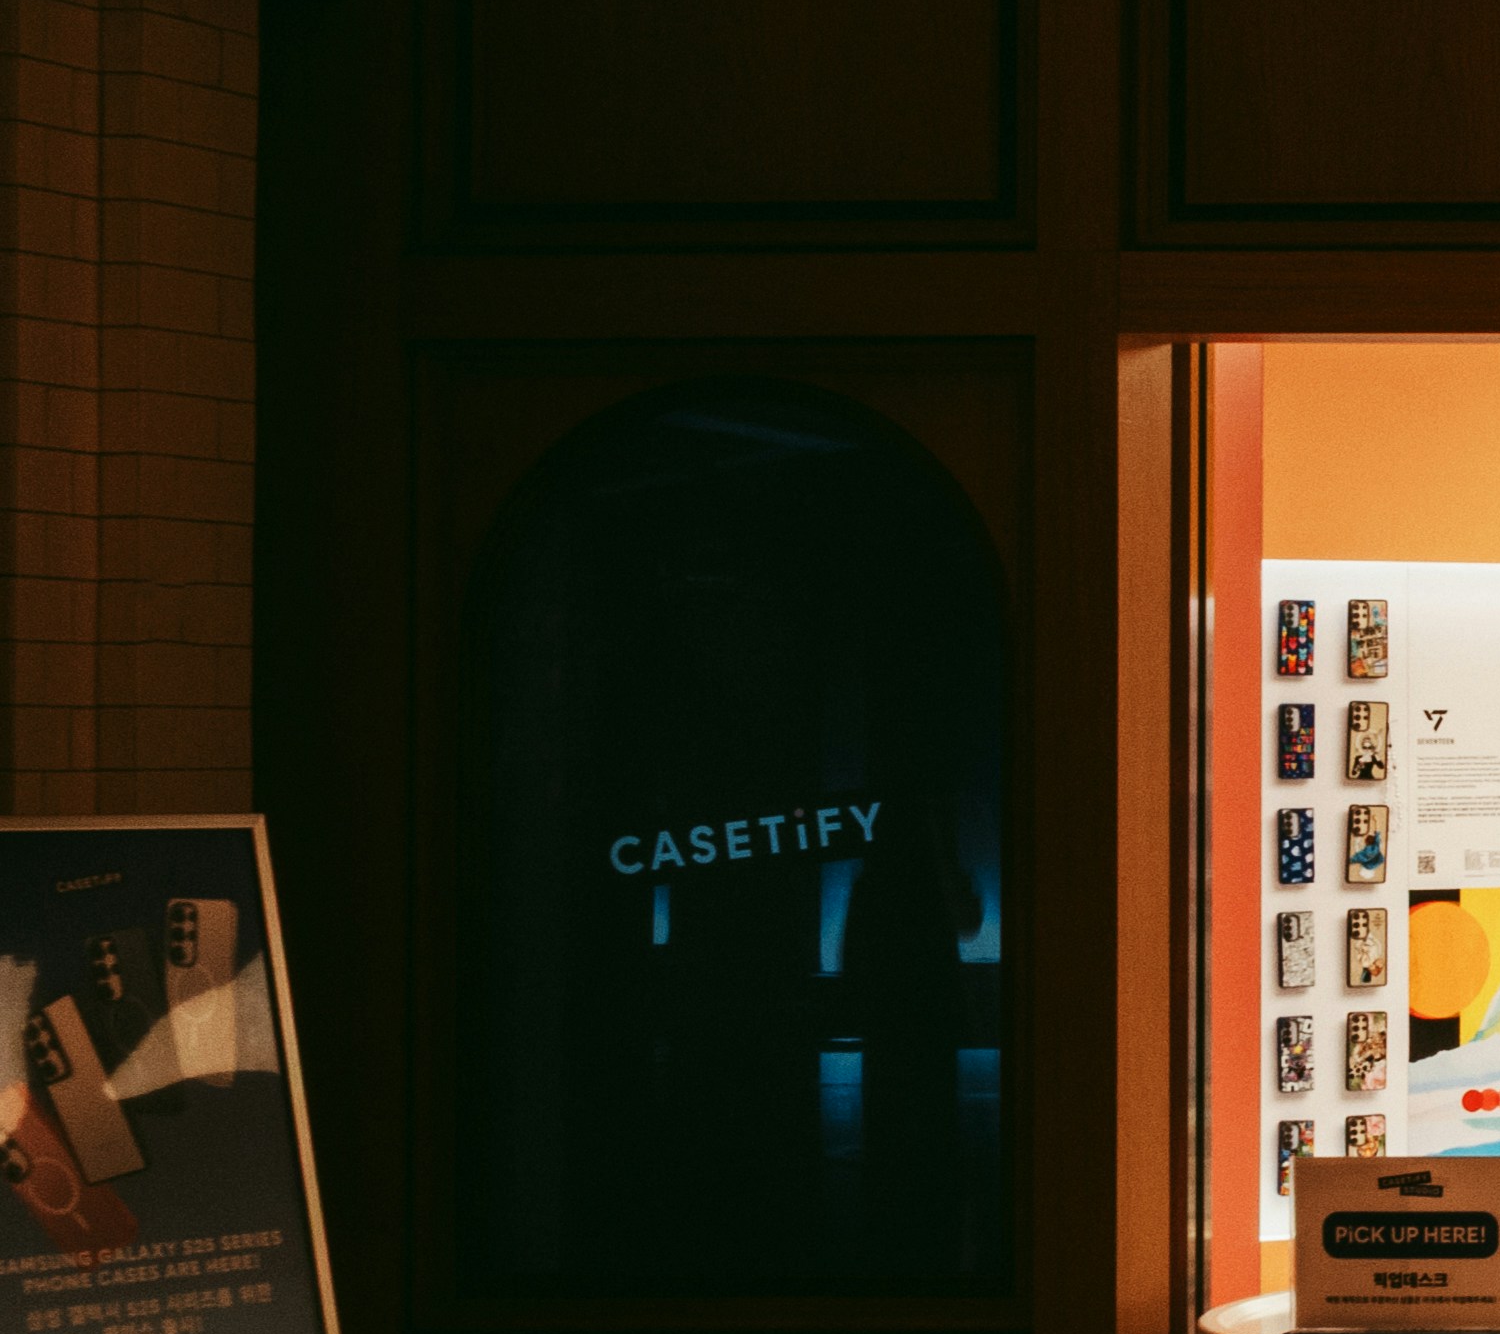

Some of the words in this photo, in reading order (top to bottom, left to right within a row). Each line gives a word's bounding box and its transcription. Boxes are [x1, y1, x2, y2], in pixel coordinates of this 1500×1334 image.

[610, 802, 881, 875] CASETiFY
[97, 1241, 177, 1264] GALAXY
[221, 1230, 284, 1252] SERIES
[1335, 1224, 1385, 1244] PiCK
[1391, 1225, 1420, 1244] UP
[1424, 1224, 1487, 1244] HERE!
[23, 1272, 92, 1295] PHONE
[97, 1264, 161, 1287] CASES
[164, 1260, 201, 1279] ARE
[1373, 1272, 1449, 1288] 픽업데스크
